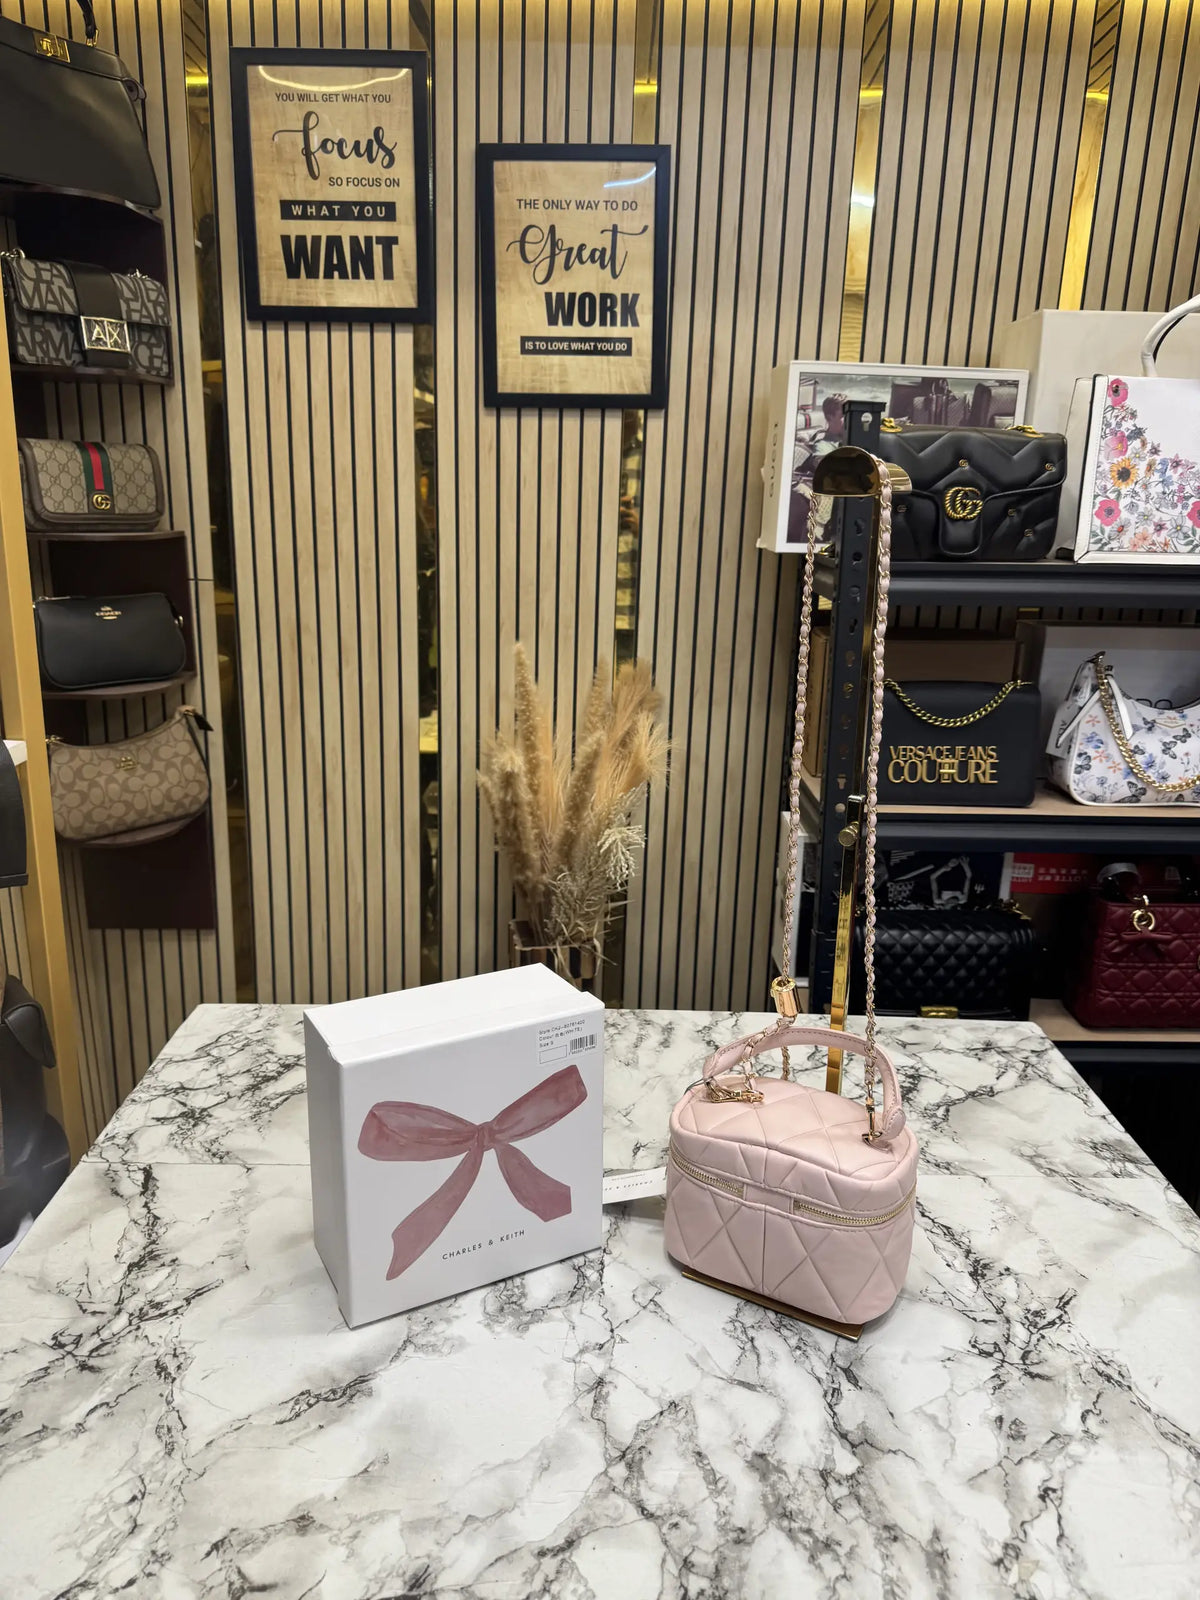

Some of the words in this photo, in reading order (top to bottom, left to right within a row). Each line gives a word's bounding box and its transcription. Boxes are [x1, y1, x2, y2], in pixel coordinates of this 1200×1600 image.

[275, 93, 295, 102] YOU
[297, 93, 319, 102] WILL
[321, 93, 340, 103] GET
[342, 93, 369, 103] WHAT
[371, 94, 391, 103] YOU
[272, 111, 398, 180] focus
[328, 177, 343, 187] SO
[346, 177, 382, 187] FOCUS
[384, 178, 400, 187] ON
[291, 205, 341, 217] WHAT
[352, 206, 386, 217] YOU
[516, 199, 540, 210] THE
[542, 199, 572, 210] ONLY
[574, 200, 602, 211] WAY
[603, 200, 619, 211] TO
[622, 200, 638, 211] DO
[280, 234, 399, 280] WANT
[506, 224, 649, 285] Great
[544, 291, 640, 328] WORK
[525, 341, 534, 350] IS
[535, 341, 547, 350] TO
[548, 341, 570, 350] LOVE
[570, 341, 596, 351] WHAT
[596, 342, 614, 351] YOU
[615, 342, 628, 351] DO
[769, 421, 779, 498] GUCCI
[889, 746, 952, 760] VERSACE
[954, 746, 997, 760] JEANS
[887, 758, 999, 784] COUTURE
[442, 1242, 483, 1260] CHARLES
[499, 1229, 526, 1243] KEITH
